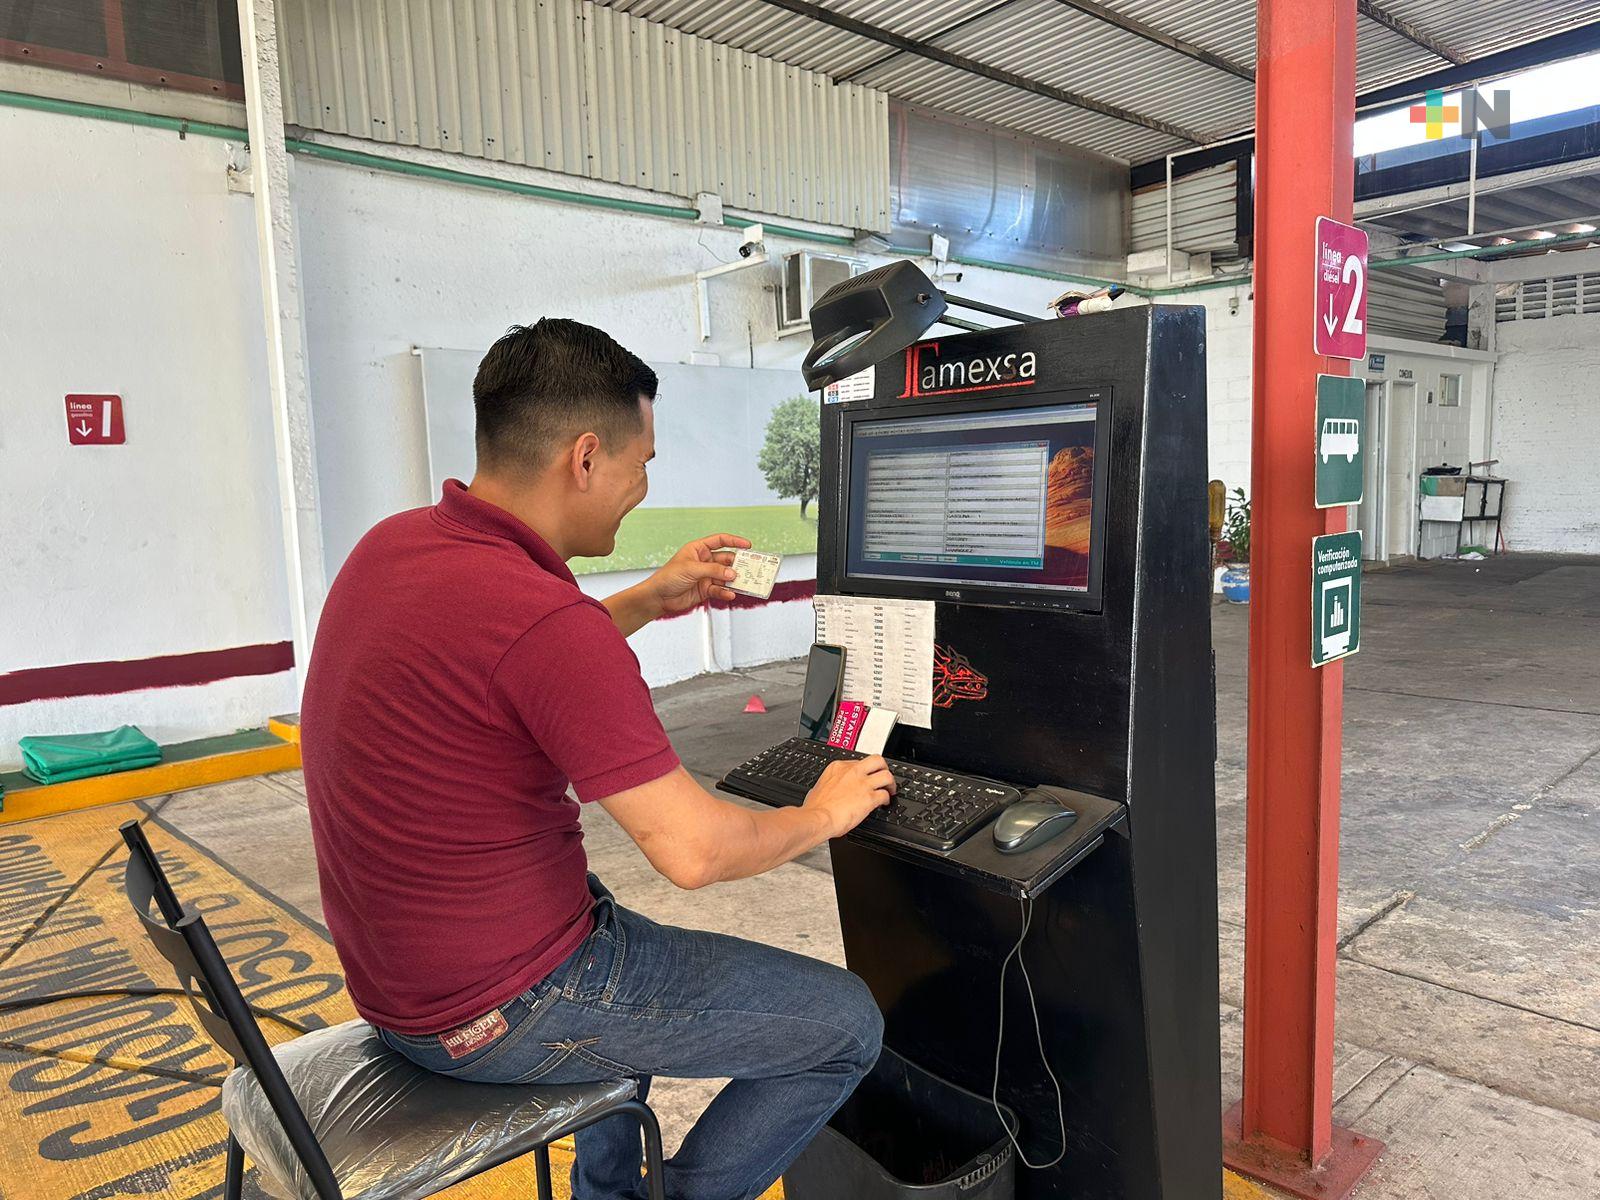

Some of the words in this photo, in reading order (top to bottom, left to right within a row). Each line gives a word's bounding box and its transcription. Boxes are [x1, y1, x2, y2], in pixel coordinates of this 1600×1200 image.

[1322, 242, 1341, 264] línea
[1342, 254, 1364, 335] 2
[896, 342, 1037, 399] Tamexsa
[69, 402, 92, 410] línea
[102, 400, 112, 437] 1
[841, 706, 861, 749] ESTATIC
[445, 1015, 498, 1047] HILFIGER
